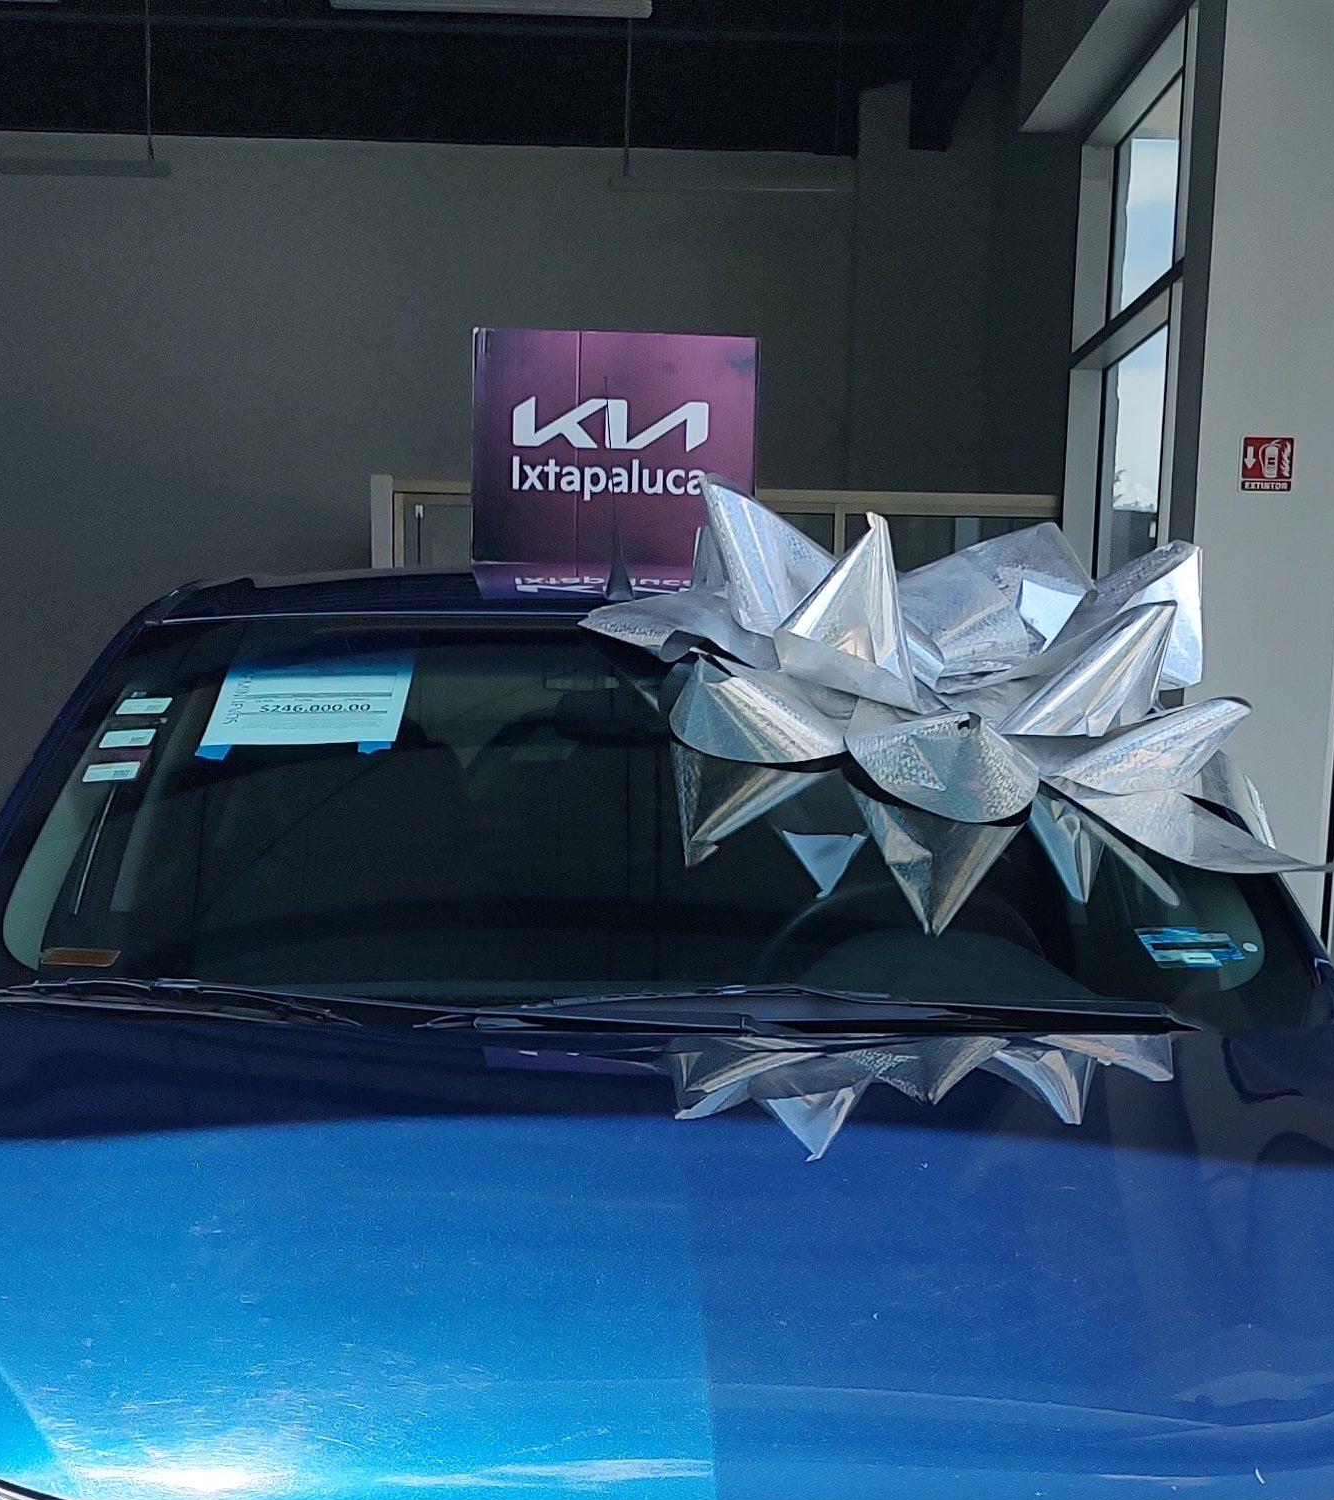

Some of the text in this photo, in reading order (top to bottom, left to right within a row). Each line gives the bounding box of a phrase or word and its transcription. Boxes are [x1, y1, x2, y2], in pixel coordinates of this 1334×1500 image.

[512, 396, 709, 452] KIA
[512, 456, 707, 501] Ixtapaluca
[1244, 481, 1288, 490] EXTINTOR
